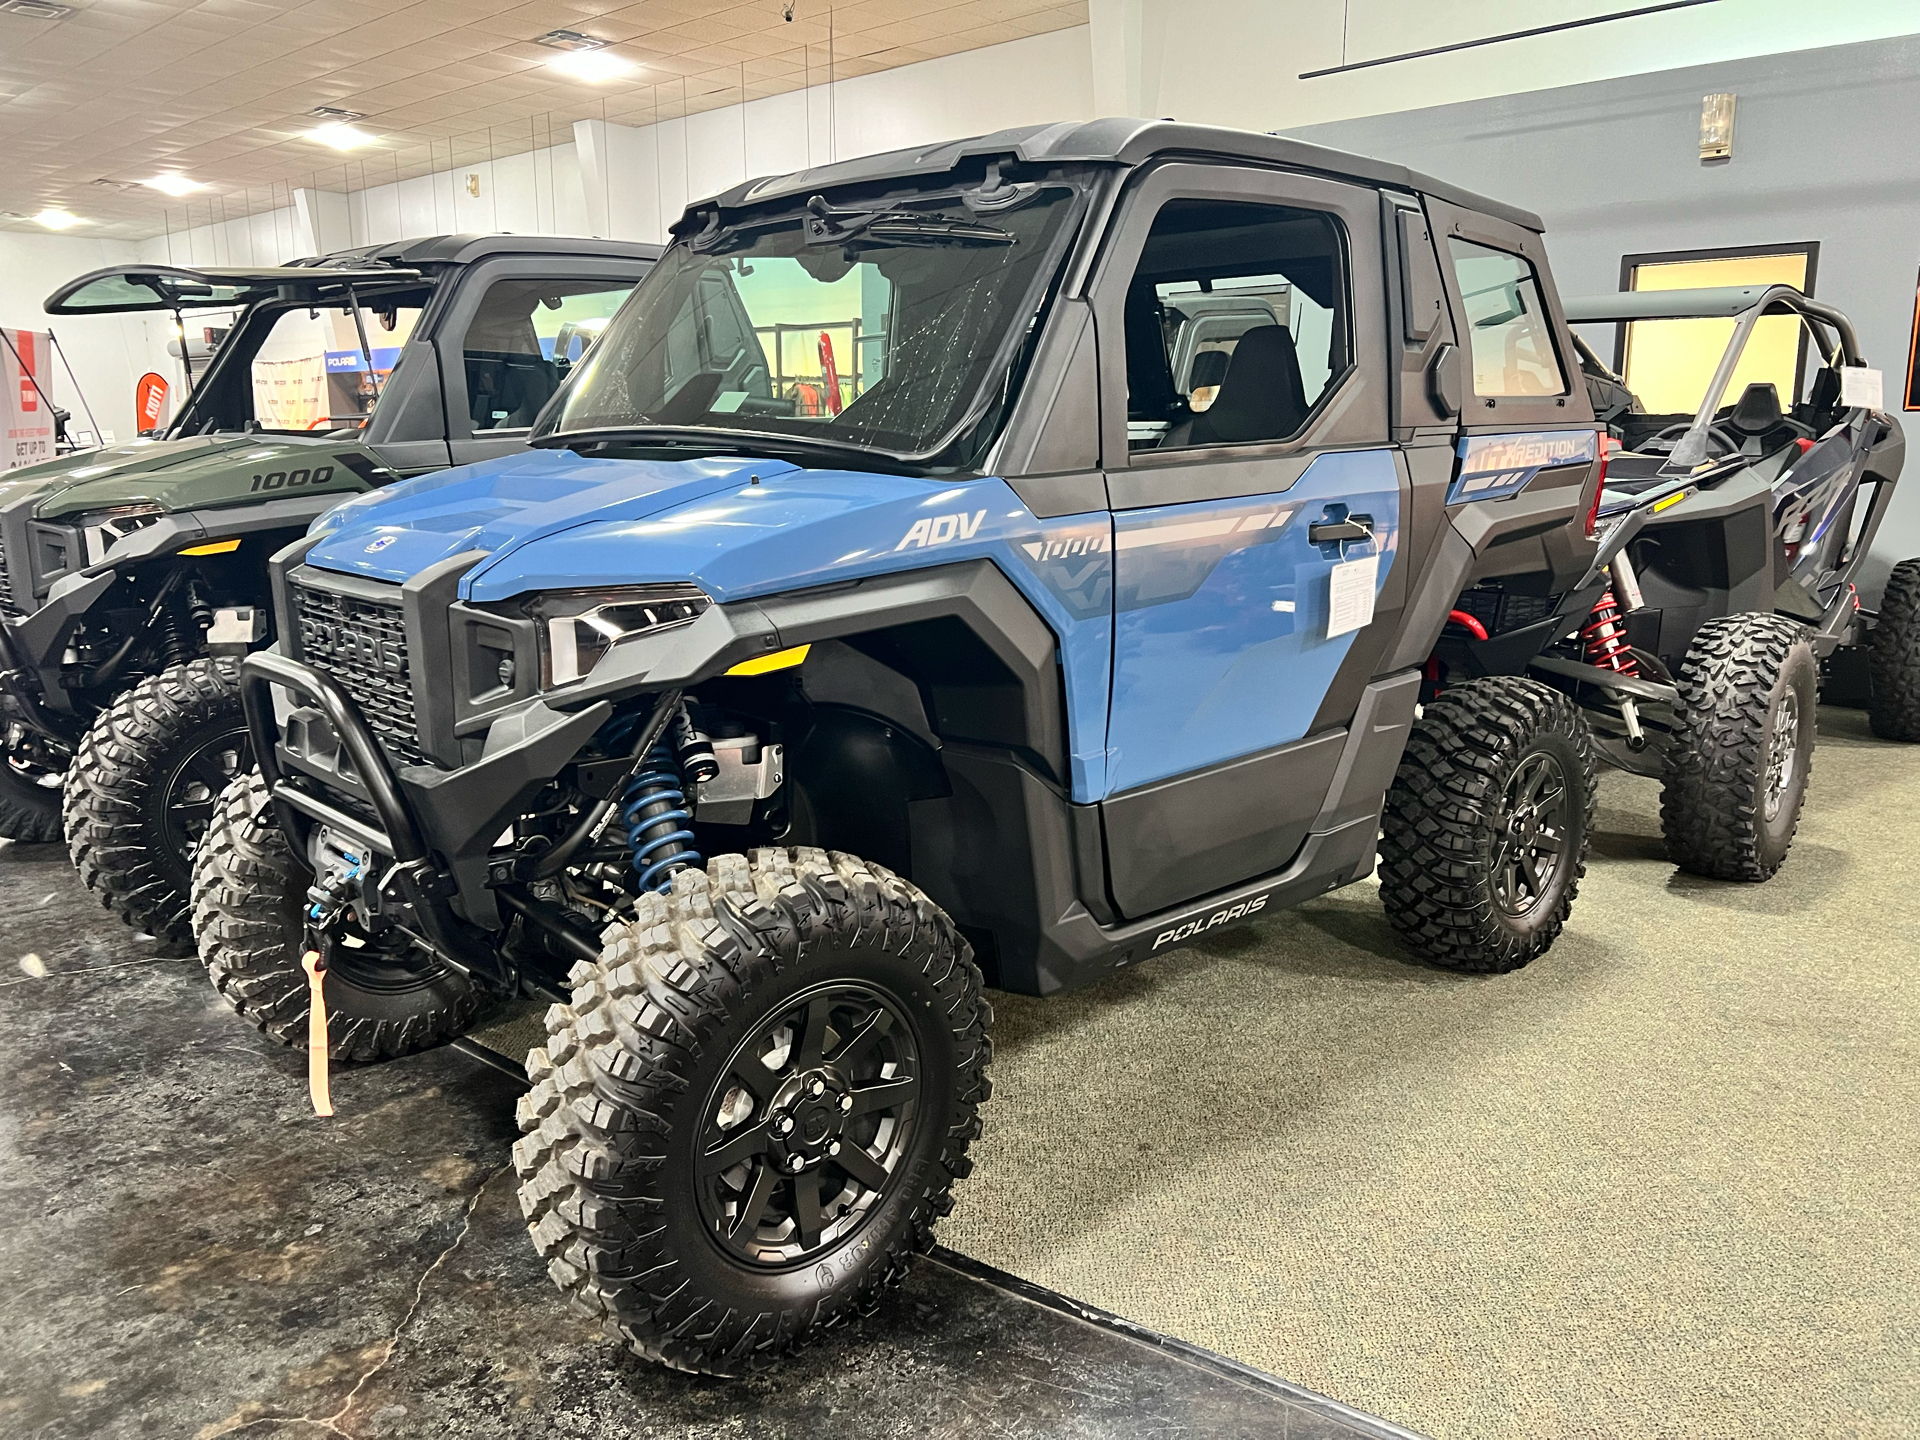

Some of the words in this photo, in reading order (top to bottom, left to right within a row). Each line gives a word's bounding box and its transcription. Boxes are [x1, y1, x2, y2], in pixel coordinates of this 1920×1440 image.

[327, 355, 357, 367] POLARIS
[144, 384, 164, 420] KIOTI
[16, 442, 28, 456] GET
[29, 441, 37, 455] UP
[38, 440, 46, 454] TO
[251, 465, 335, 492] 1000
[894, 509, 987, 551] ADV
[300, 618, 401, 673] POLARIS
[1152, 894, 1270, 951] POLARIS
